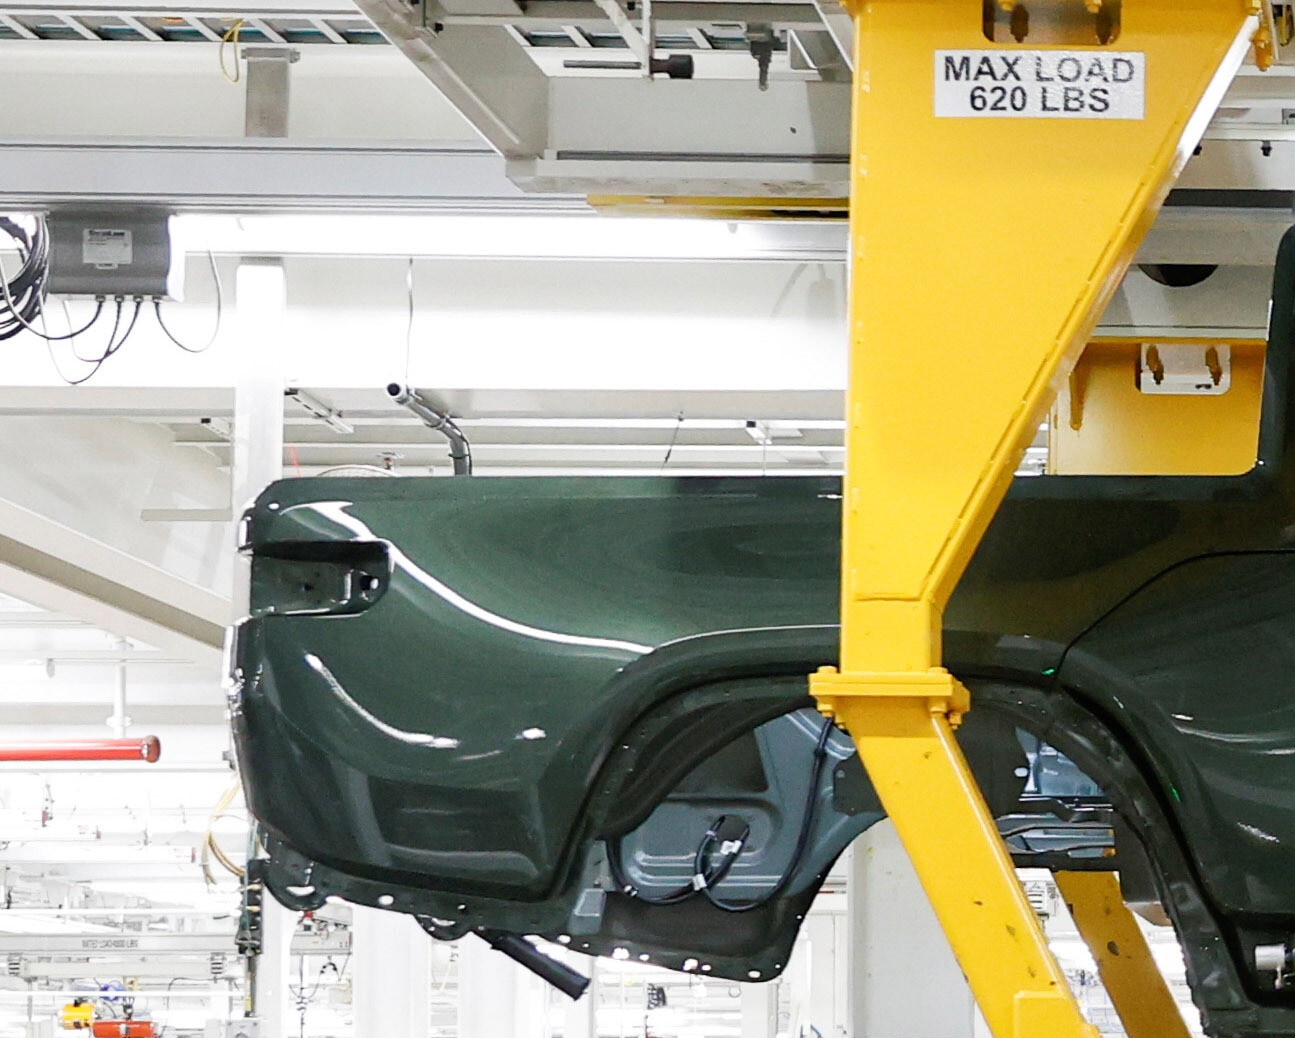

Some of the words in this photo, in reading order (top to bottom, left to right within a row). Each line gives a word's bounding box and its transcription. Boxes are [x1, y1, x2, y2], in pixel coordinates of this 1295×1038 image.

[945, 56, 1022, 81] MAX
[1036, 56, 1135, 82] LOAD
[969, 86, 1027, 111] 620
[1041, 87, 1110, 112] LBS
